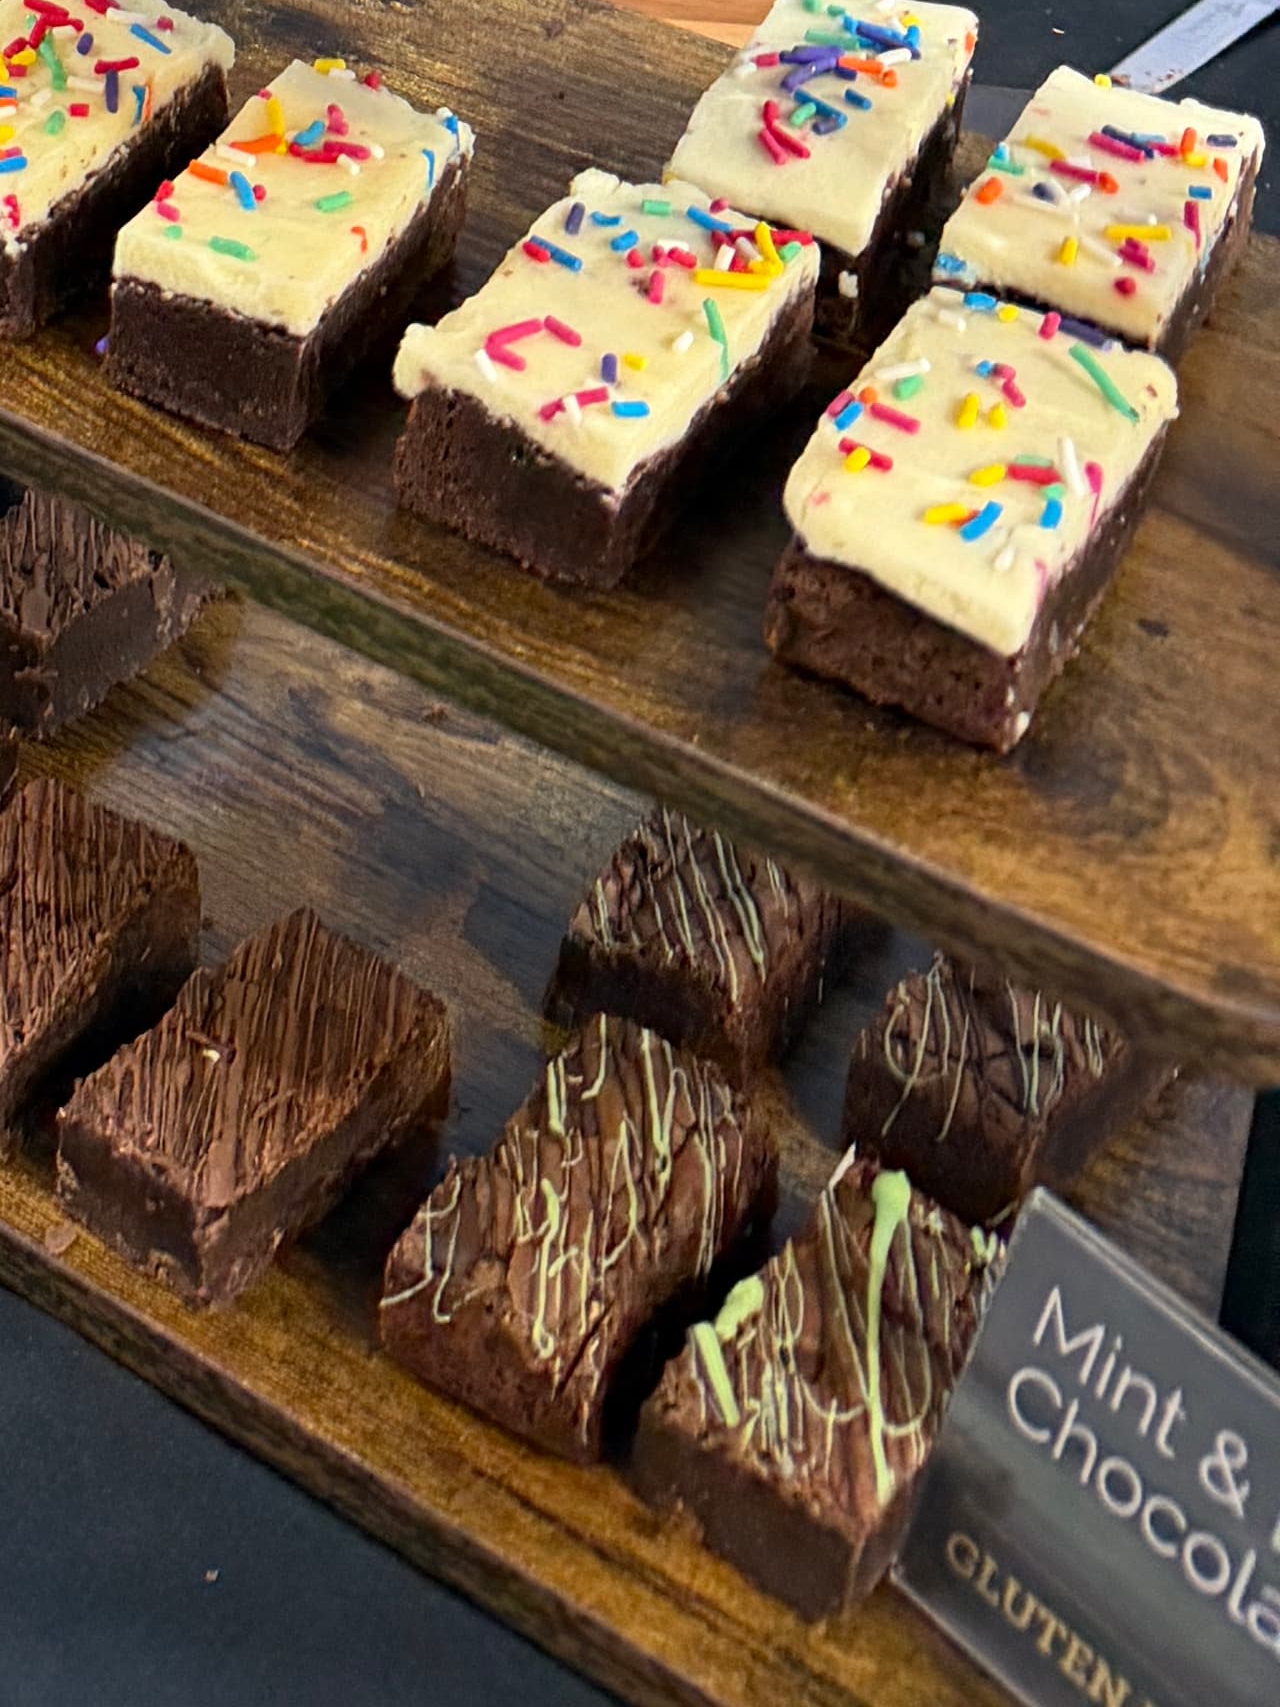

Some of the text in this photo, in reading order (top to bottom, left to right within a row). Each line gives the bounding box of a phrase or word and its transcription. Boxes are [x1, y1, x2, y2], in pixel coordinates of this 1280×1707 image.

[1033, 1286, 1251, 1520] Mint &
[947, 1532, 1132, 1707] GLUTEN
